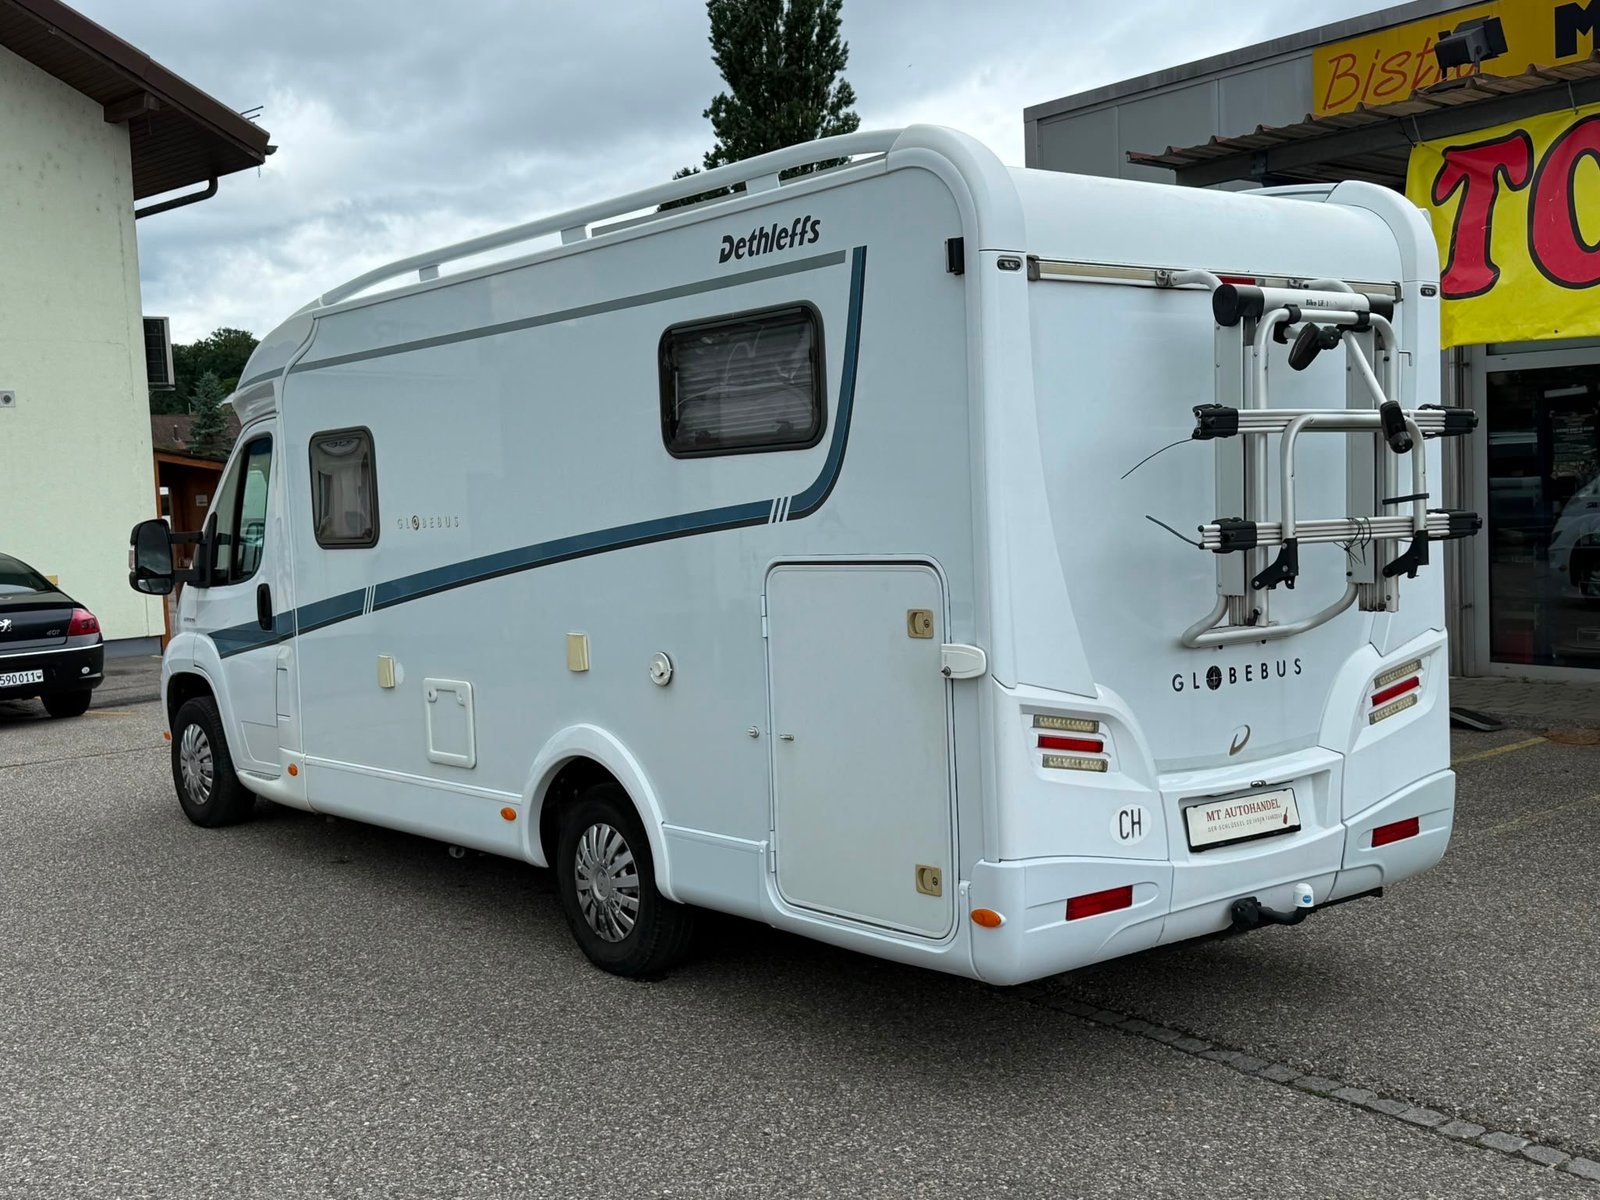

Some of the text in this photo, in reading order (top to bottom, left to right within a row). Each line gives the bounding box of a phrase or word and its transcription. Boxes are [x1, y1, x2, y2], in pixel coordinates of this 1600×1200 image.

[719, 215, 820, 264] Dethleffs
[397, 514, 460, 531] GLOBEBUS
[1172, 657, 1302, 692] GLOBEBUS
[1119, 807, 1142, 840] CH
[1206, 798, 1281, 822] MT AUTOHANDEL
